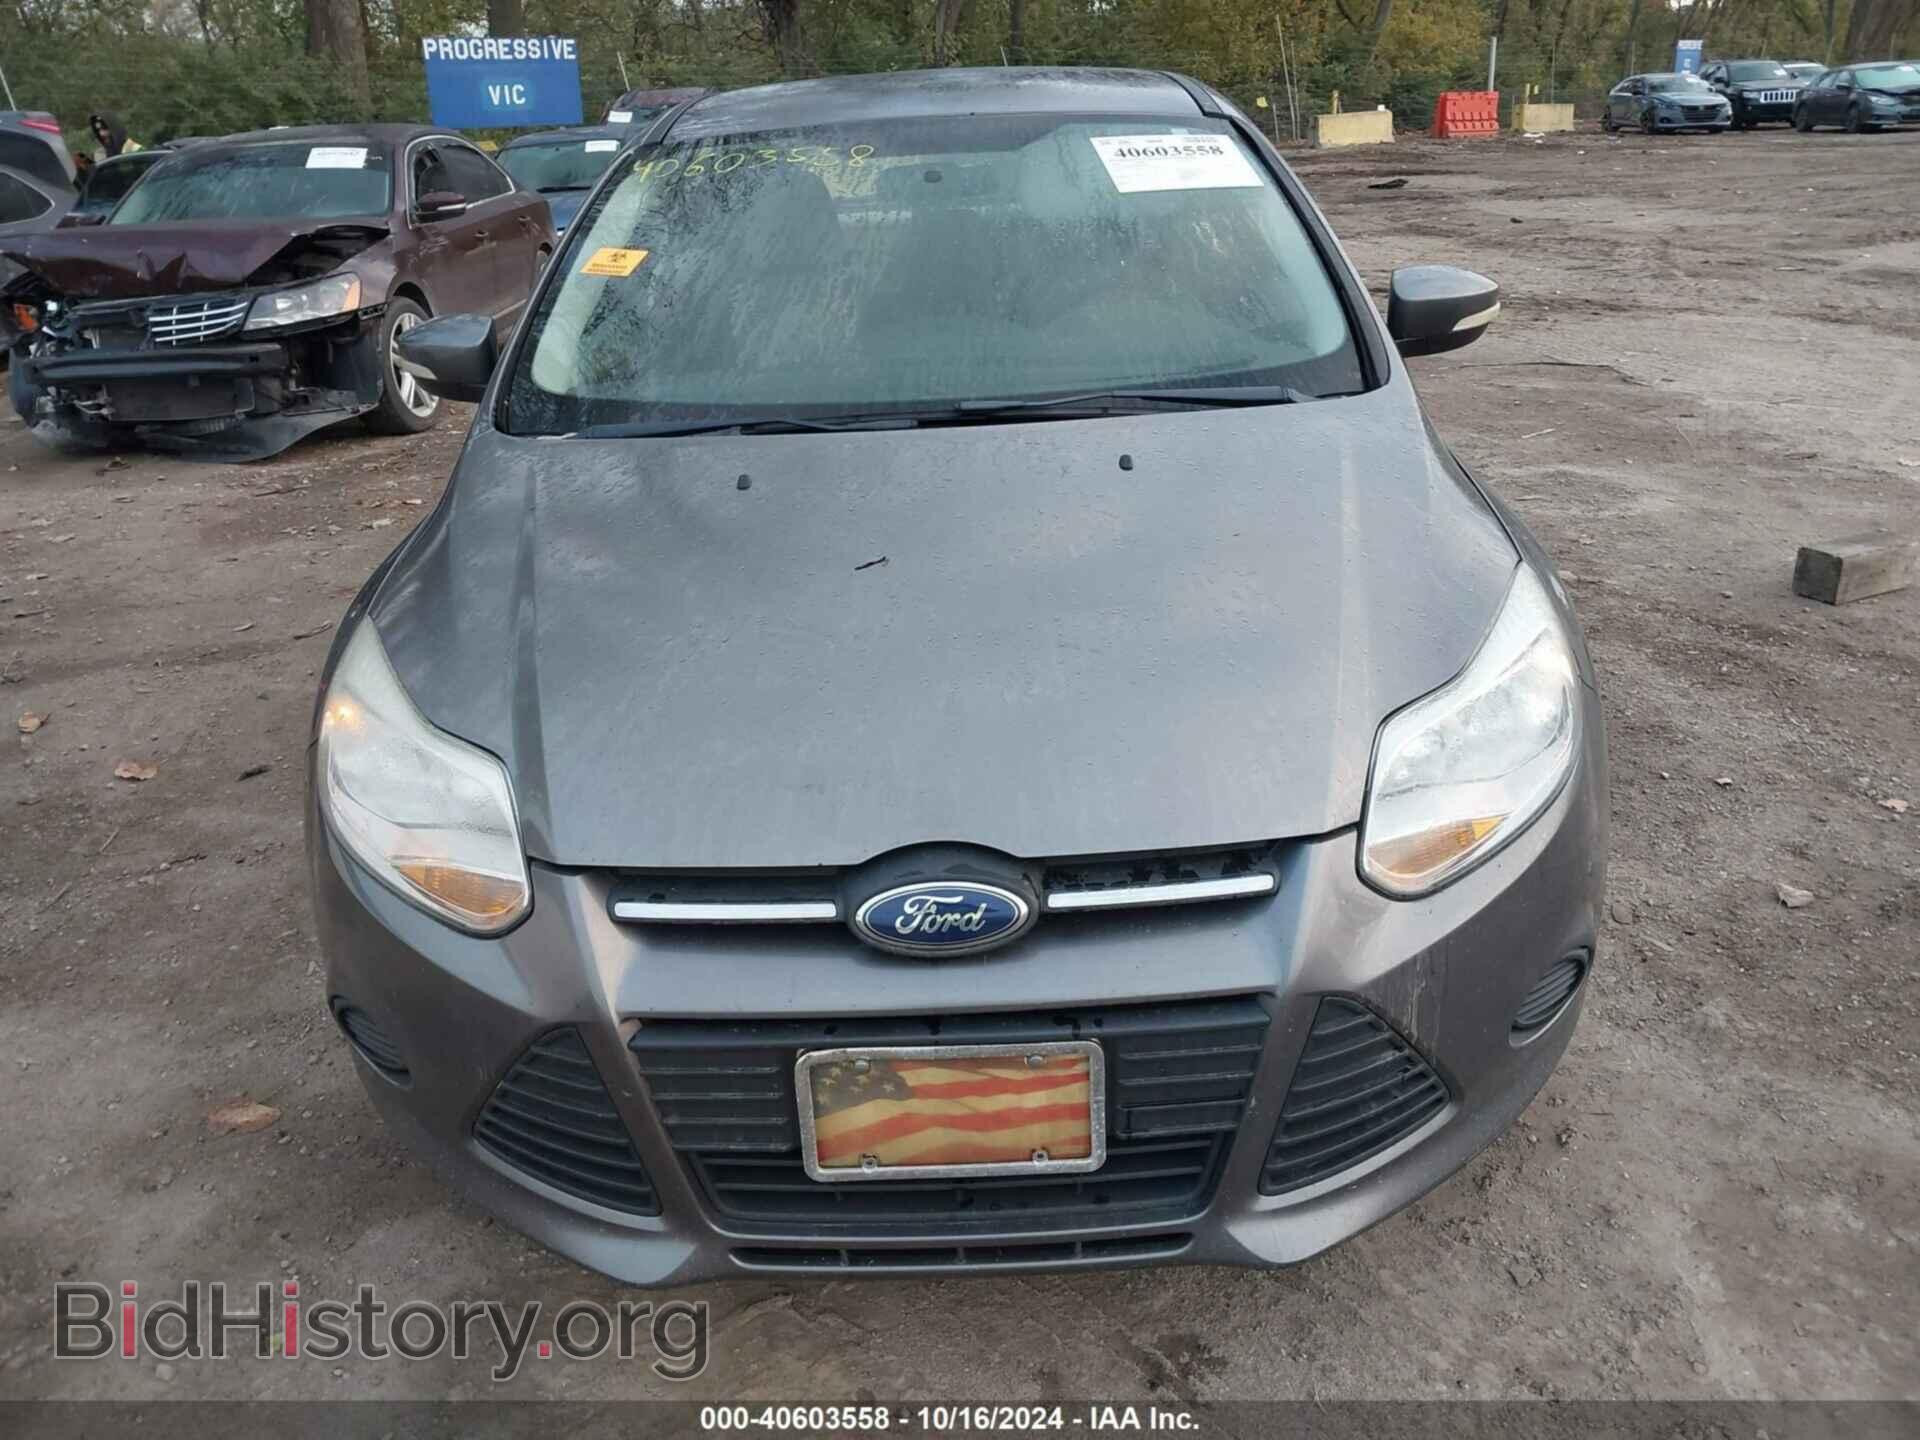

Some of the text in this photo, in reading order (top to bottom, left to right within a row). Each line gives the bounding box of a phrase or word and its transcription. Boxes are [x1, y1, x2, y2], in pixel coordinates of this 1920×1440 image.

[422, 38, 577, 60] PROGRESSIVE
[488, 84, 526, 105] VIC
[894, 895, 987, 934] Ford
